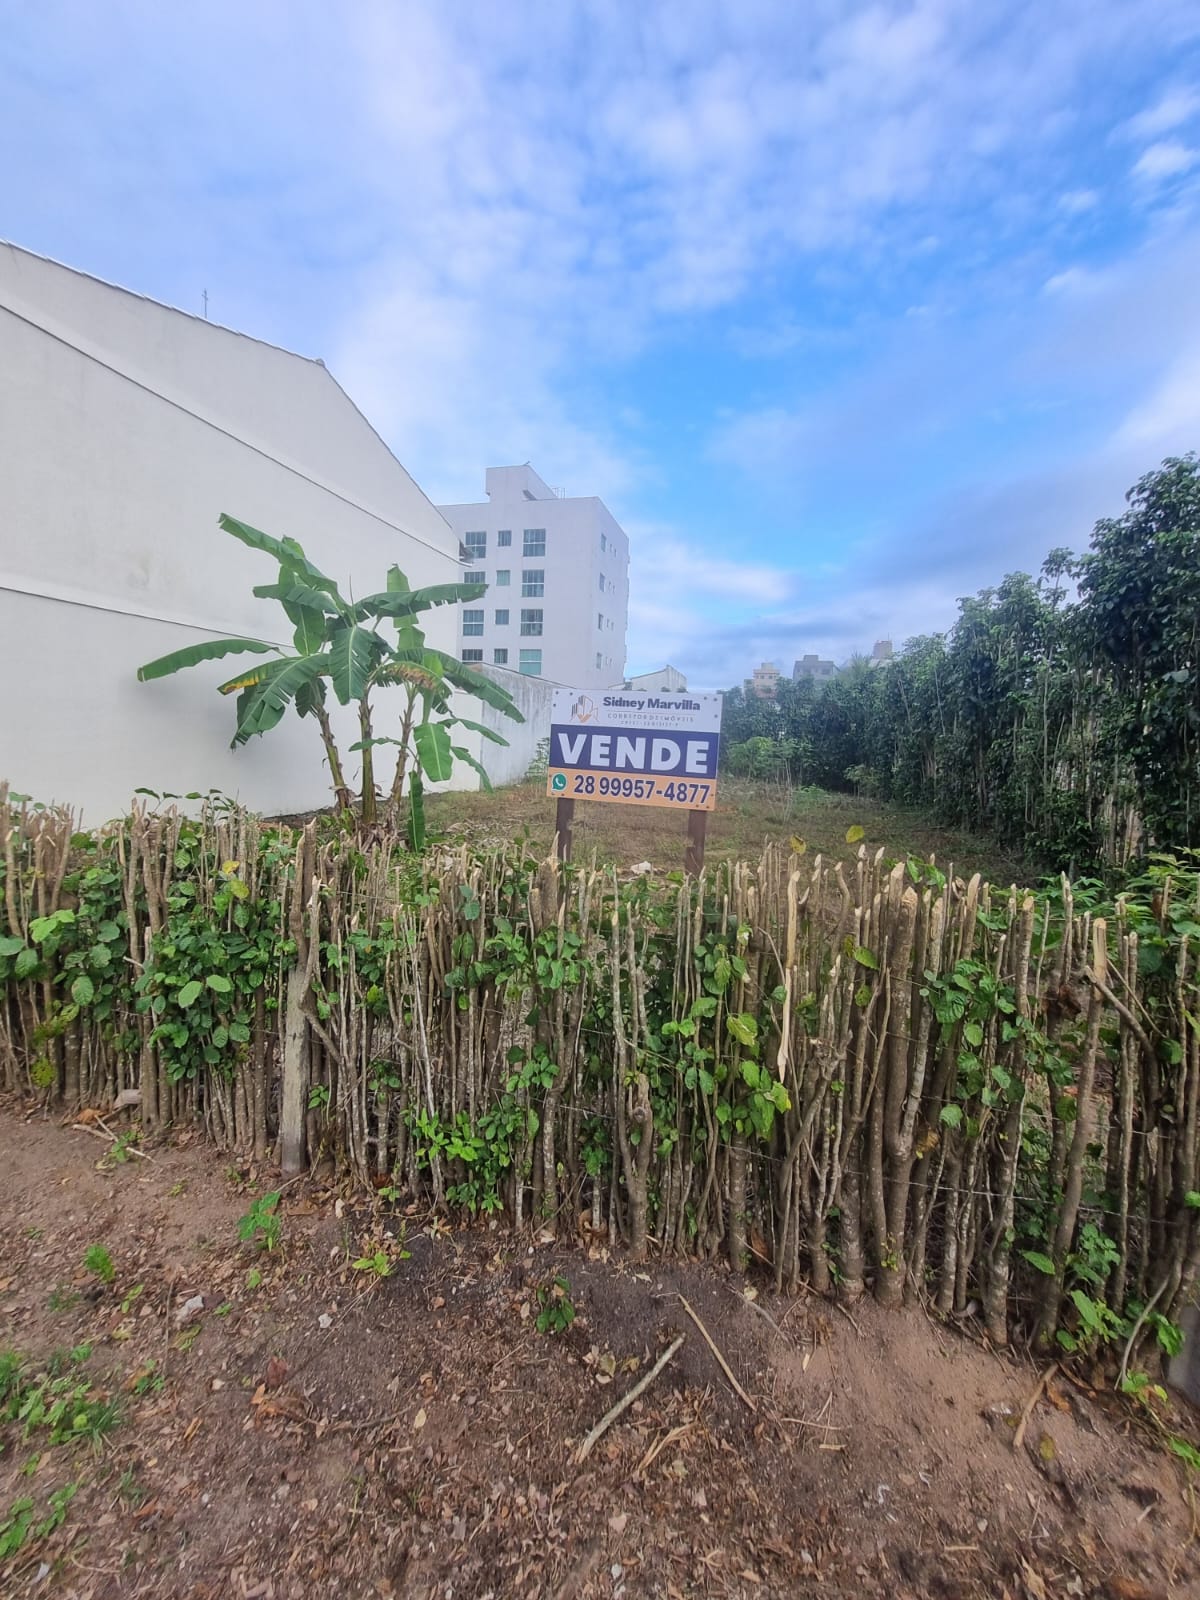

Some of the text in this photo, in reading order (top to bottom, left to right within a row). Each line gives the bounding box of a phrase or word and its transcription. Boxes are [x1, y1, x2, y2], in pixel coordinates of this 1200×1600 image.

[603, 696, 701, 711] Sidney Marvilla
[557, 733, 710, 774] VENDE
[574, 775, 710, 804] 28 99957-4877
